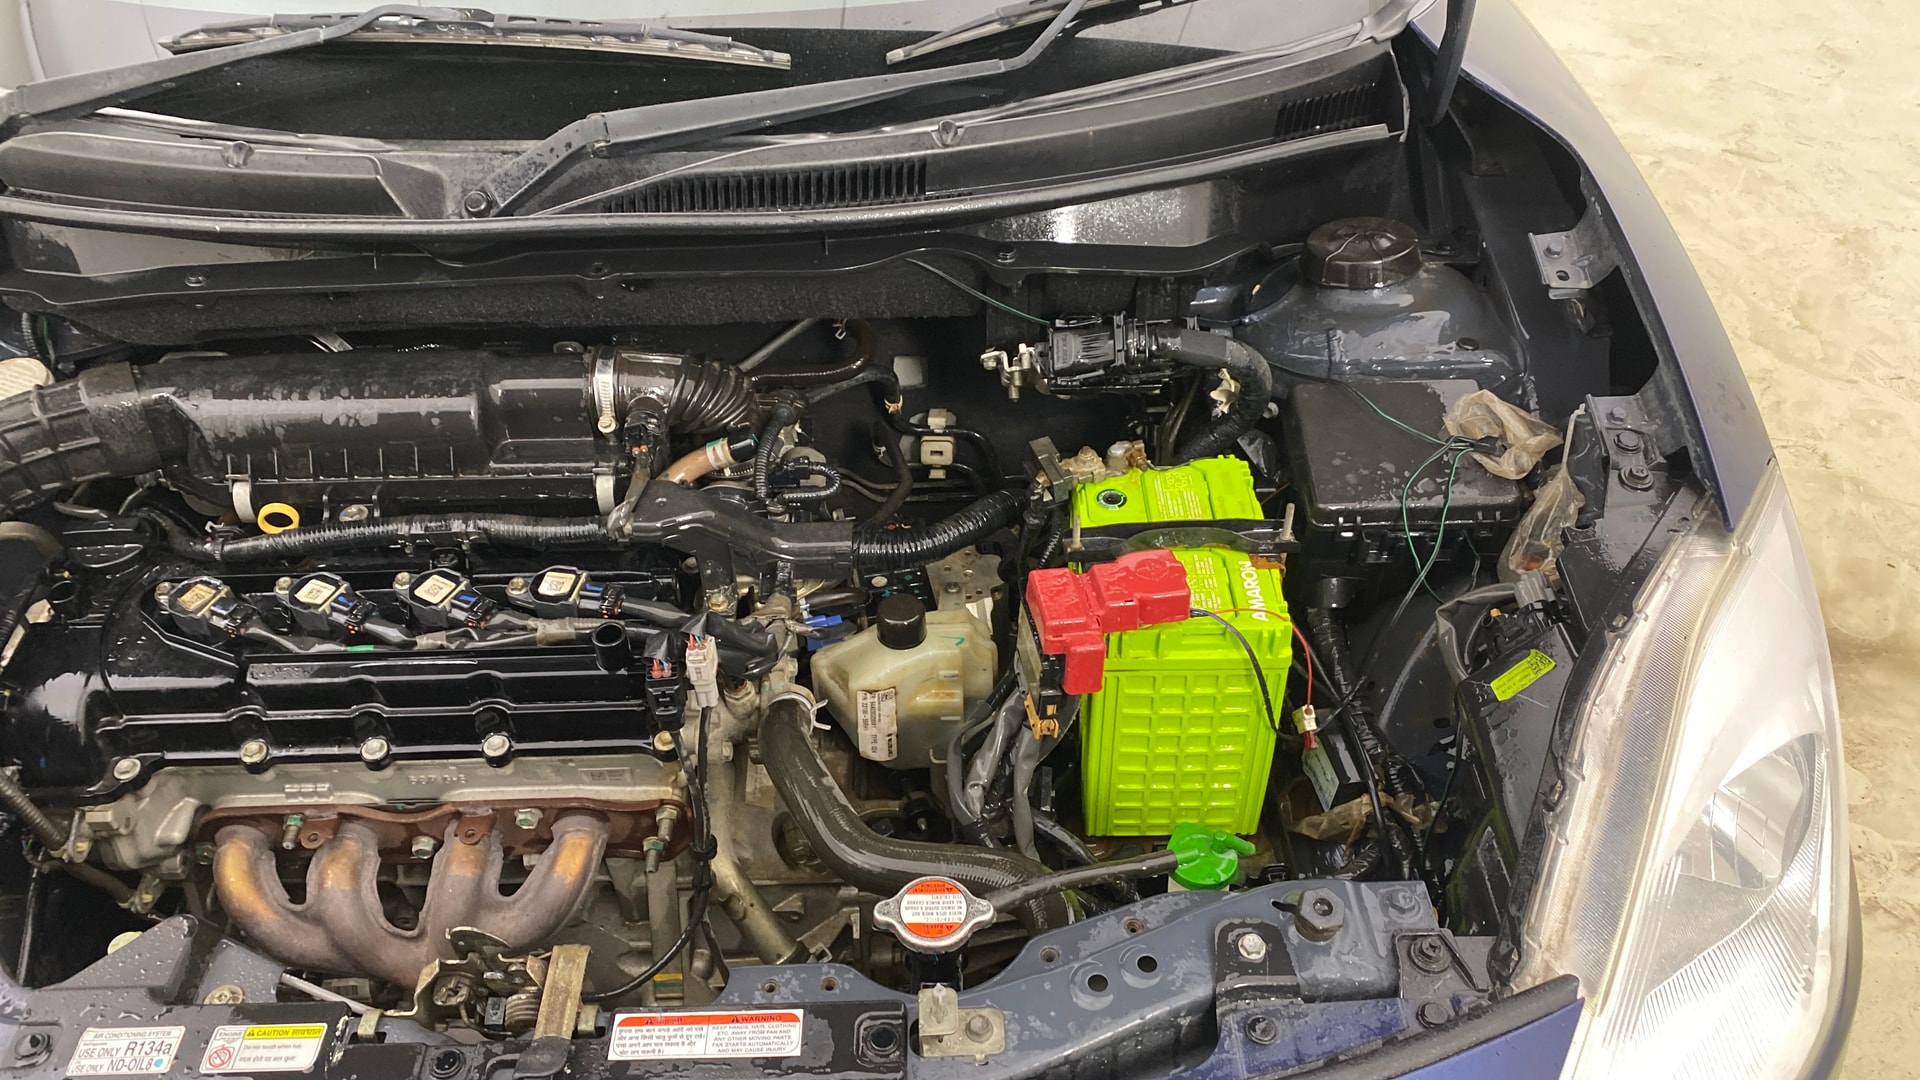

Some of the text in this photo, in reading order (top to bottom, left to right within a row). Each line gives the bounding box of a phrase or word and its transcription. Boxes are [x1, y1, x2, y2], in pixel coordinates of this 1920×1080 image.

[1239, 560, 1270, 622] AMARON
[78, 1040, 173, 1058] USE ONLY R134a
[71, 1058, 153, 1073] USE ONLY ND-OIL8
